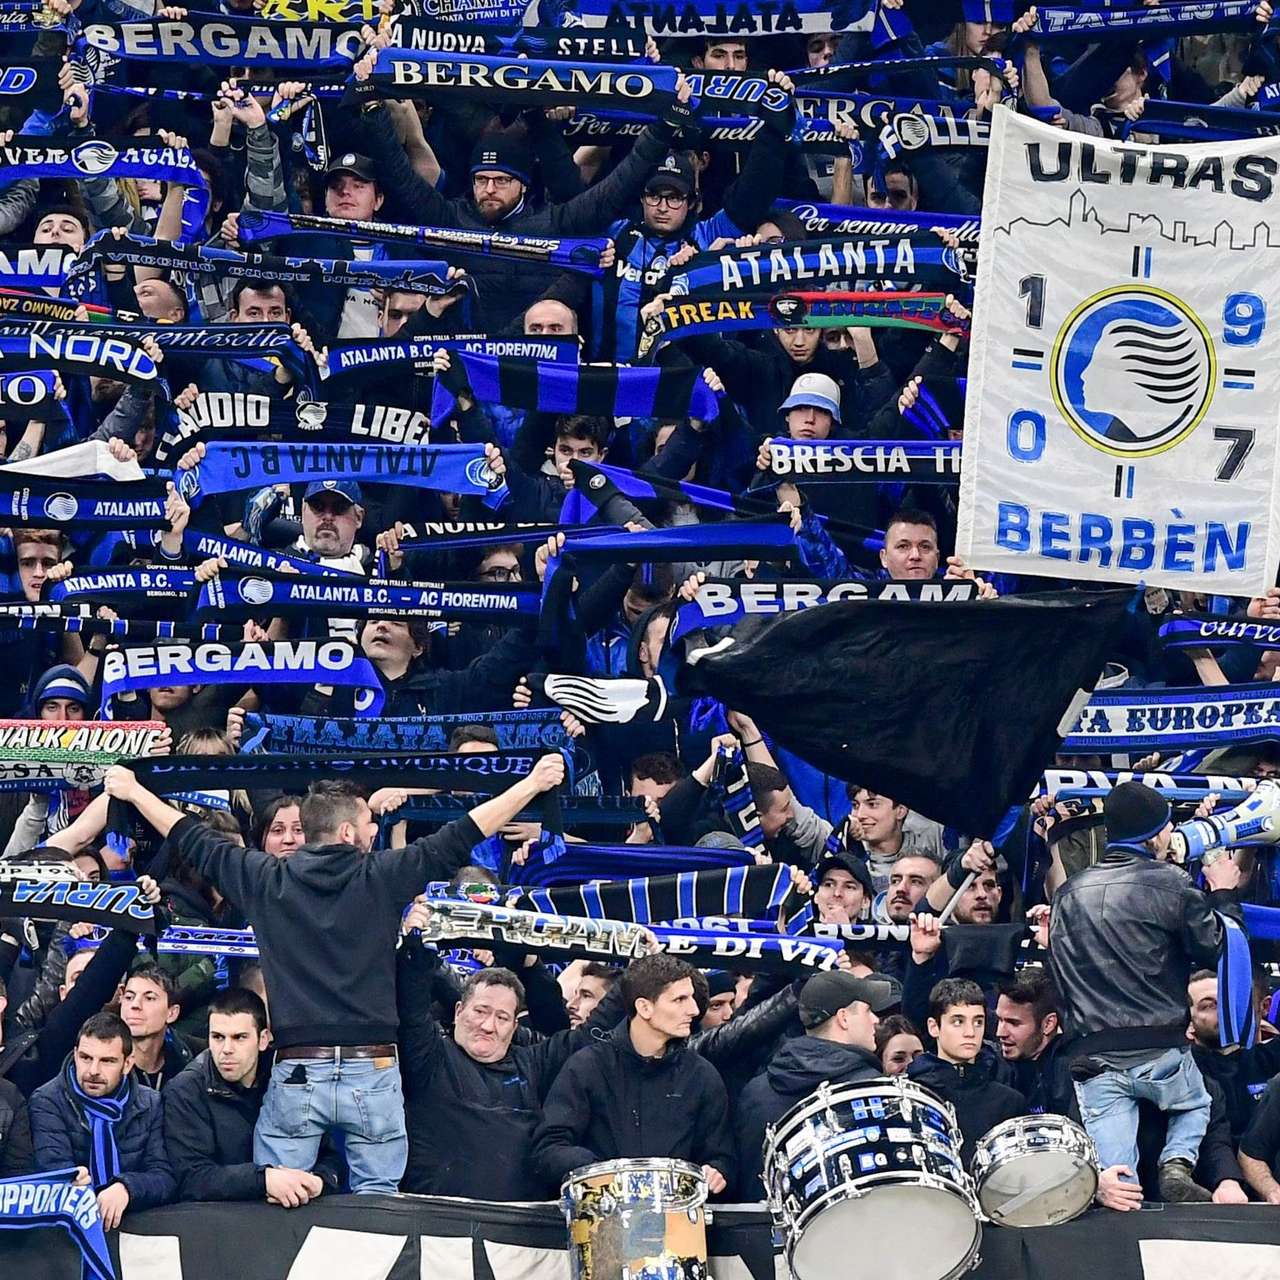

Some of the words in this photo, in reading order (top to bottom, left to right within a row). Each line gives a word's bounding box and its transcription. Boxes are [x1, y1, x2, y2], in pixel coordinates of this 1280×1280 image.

[392, 60, 654, 98] BERGAMO
[1024, 142, 1280, 202] ULTRAS
[720, 239, 916, 292] ATALANTA
[666, 299, 755, 328] FREAK
[1017, 274, 1049, 330] 1
[1221, 292, 1267, 348] 9
[28, 334, 158, 380] NORD
[339, 346, 407, 367] ATALANTA
[464, 341, 487, 354] AC
[491, 342, 558, 361] FIORENTINA
[288, 445, 442, 478] ATALANTA
[770, 445, 913, 475] BRESCIA
[1005, 410, 1049, 463] 0
[1213, 425, 1256, 483] 7
[196, 536, 262, 566] ATALANTA
[994, 501, 1252, 575] BERBÈN
[289, 585, 359, 602] ATALANTA
[362, 588, 393, 603] B.C.
[419, 590, 441, 606] AC
[444, 591, 518, 610] FIORENTINA
[103, 642, 354, 681] BERGAMO
[80, 726, 161, 755] ALONE
[12, 878, 156, 922] CURVA
[721, 932, 766, 958] DI
